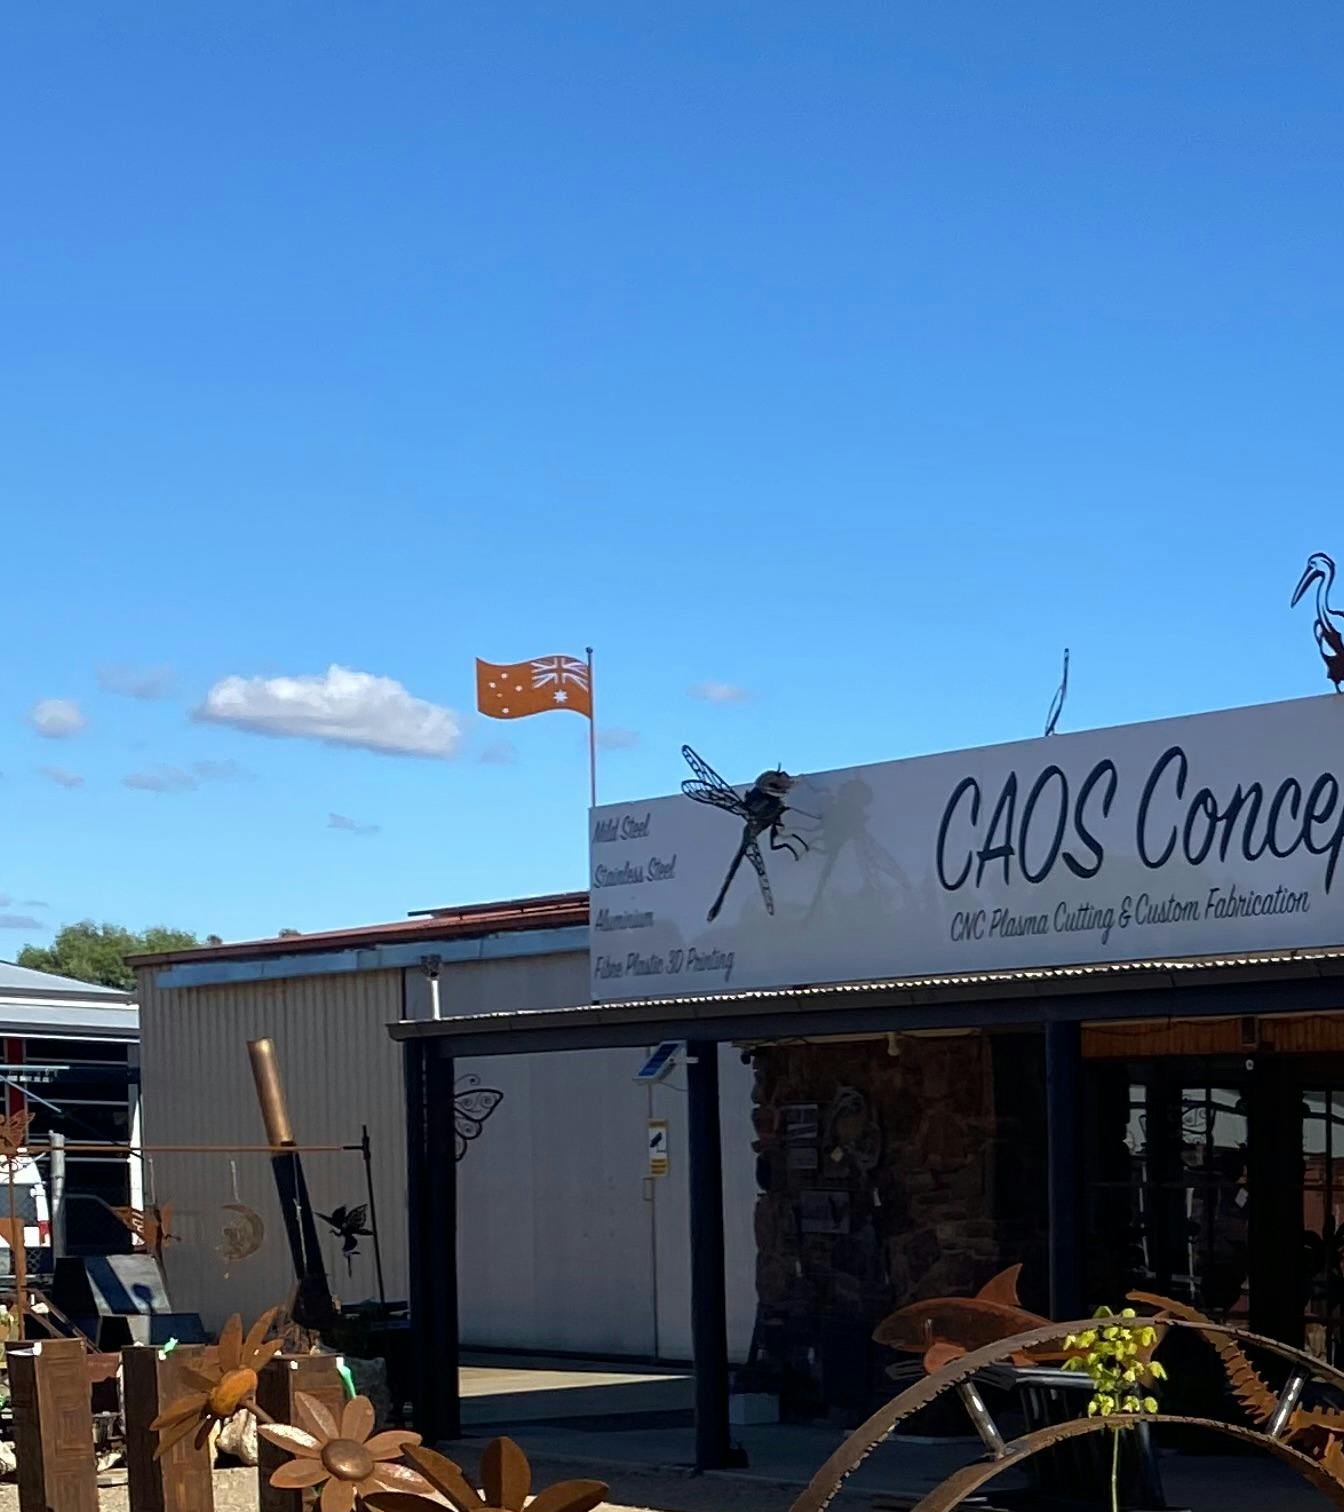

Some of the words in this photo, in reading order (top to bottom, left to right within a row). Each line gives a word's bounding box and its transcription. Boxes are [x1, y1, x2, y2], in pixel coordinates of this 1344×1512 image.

[592, 819, 618, 843] Mild
[619, 812, 650, 841] Steel
[936, 758, 1118, 891] CAOS
[592, 860, 643, 888] Stainless
[645, 853, 676, 882] Steel
[950, 909, 986, 942] CNC
[988, 907, 1049, 938] Plasma
[1053, 900, 1114, 945] Cutting
[1118, 895, 1132, 928] &
[1135, 892, 1200, 925] Custom
[1204, 884, 1310, 920] Fabrication
[625, 951, 663, 976] Plastic
[665, 948, 684, 974] 3D
[686, 946, 735, 984] Printing
